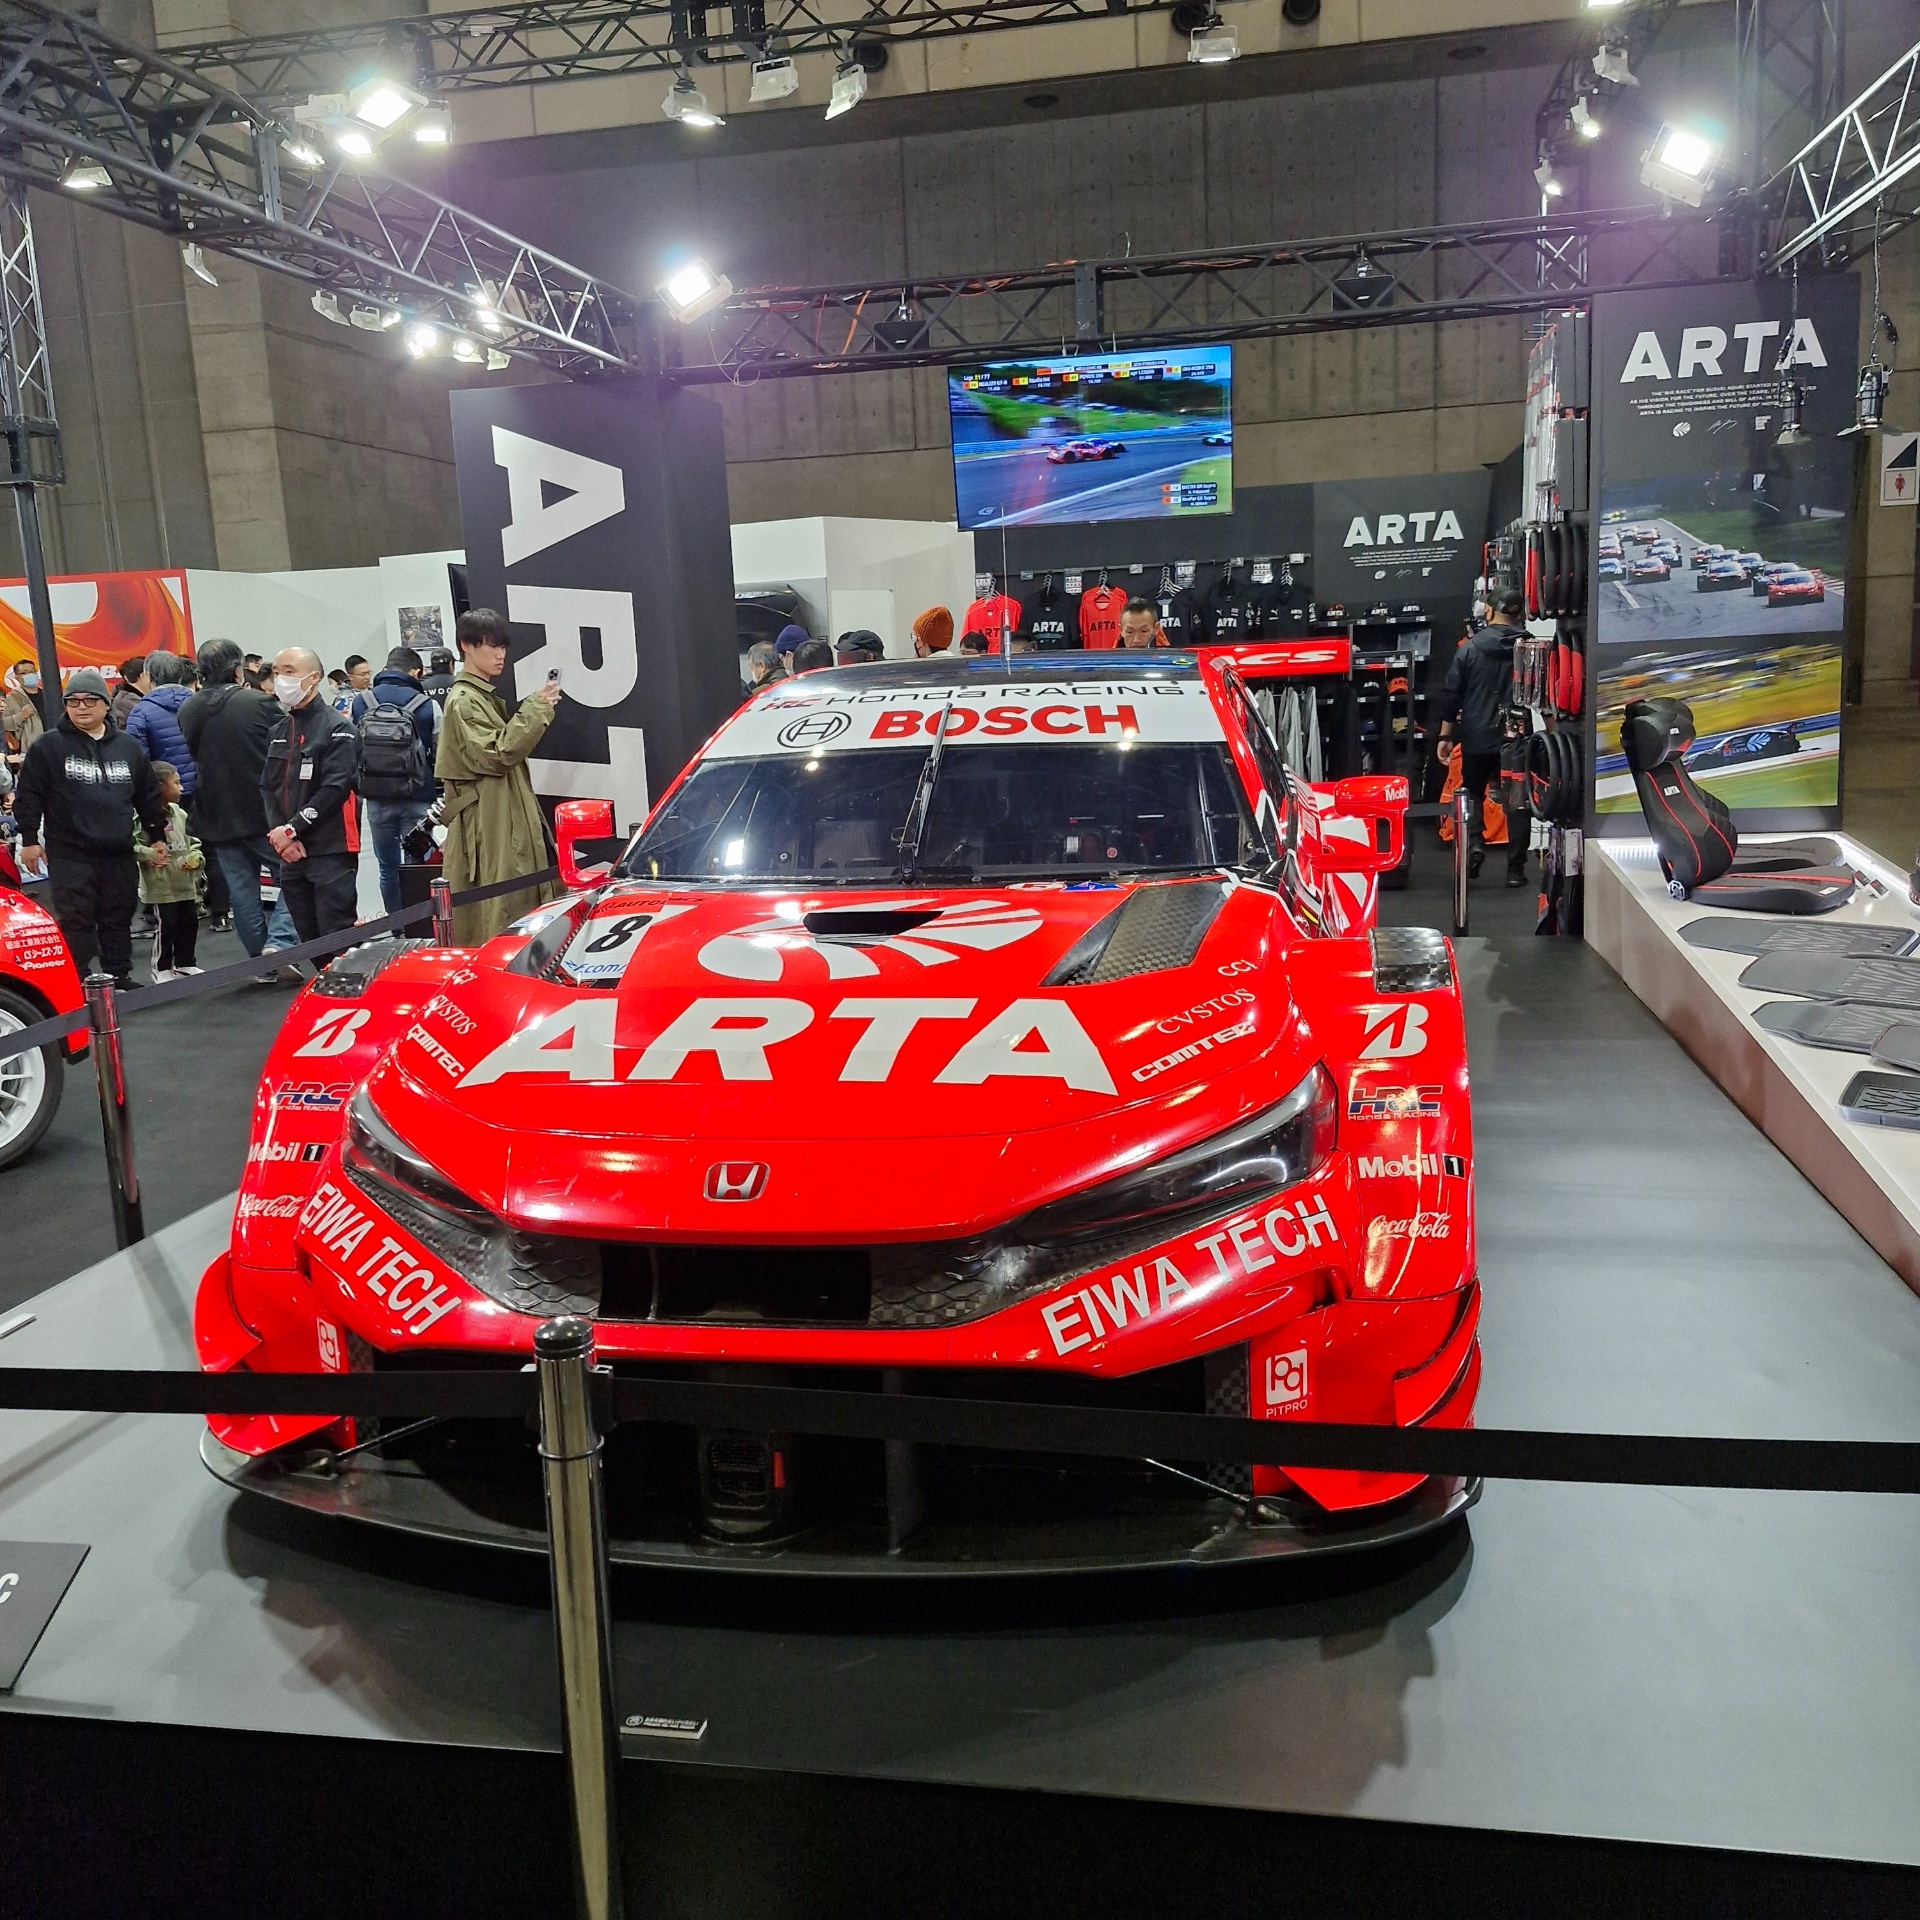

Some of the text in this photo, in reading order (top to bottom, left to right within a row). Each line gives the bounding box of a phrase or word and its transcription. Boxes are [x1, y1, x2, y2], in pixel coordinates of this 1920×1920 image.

[1620, 318, 1827, 383] ARTA
[1343, 510, 1464, 548] ARTA
[1032, 621, 1065, 633] ARTA
[1089, 620, 1116, 632] ARTA
[1160, 617, 1181, 628] RTA
[826, 689, 987, 706] Honda
[1001, 685, 1185, 698] RACING
[869, 704, 1140, 740] BOSCH
[584, 914, 653, 953] 8
[22, 959, 67, 971] Pioneer
[1156, 988, 1256, 1034] CVSTOS
[455, 998, 1119, 1096] ARTA
[1393, 1110, 1441, 1120] RACING
[249, 1142, 301, 1163] Mobil
[1357, 1153, 1439, 1179] Mobil
[300, 1181, 463, 1335] EIWA TECH
[1040, 1193, 1339, 1357] EIWA TECH
[1266, 1399, 1308, 1419] PITPRO
